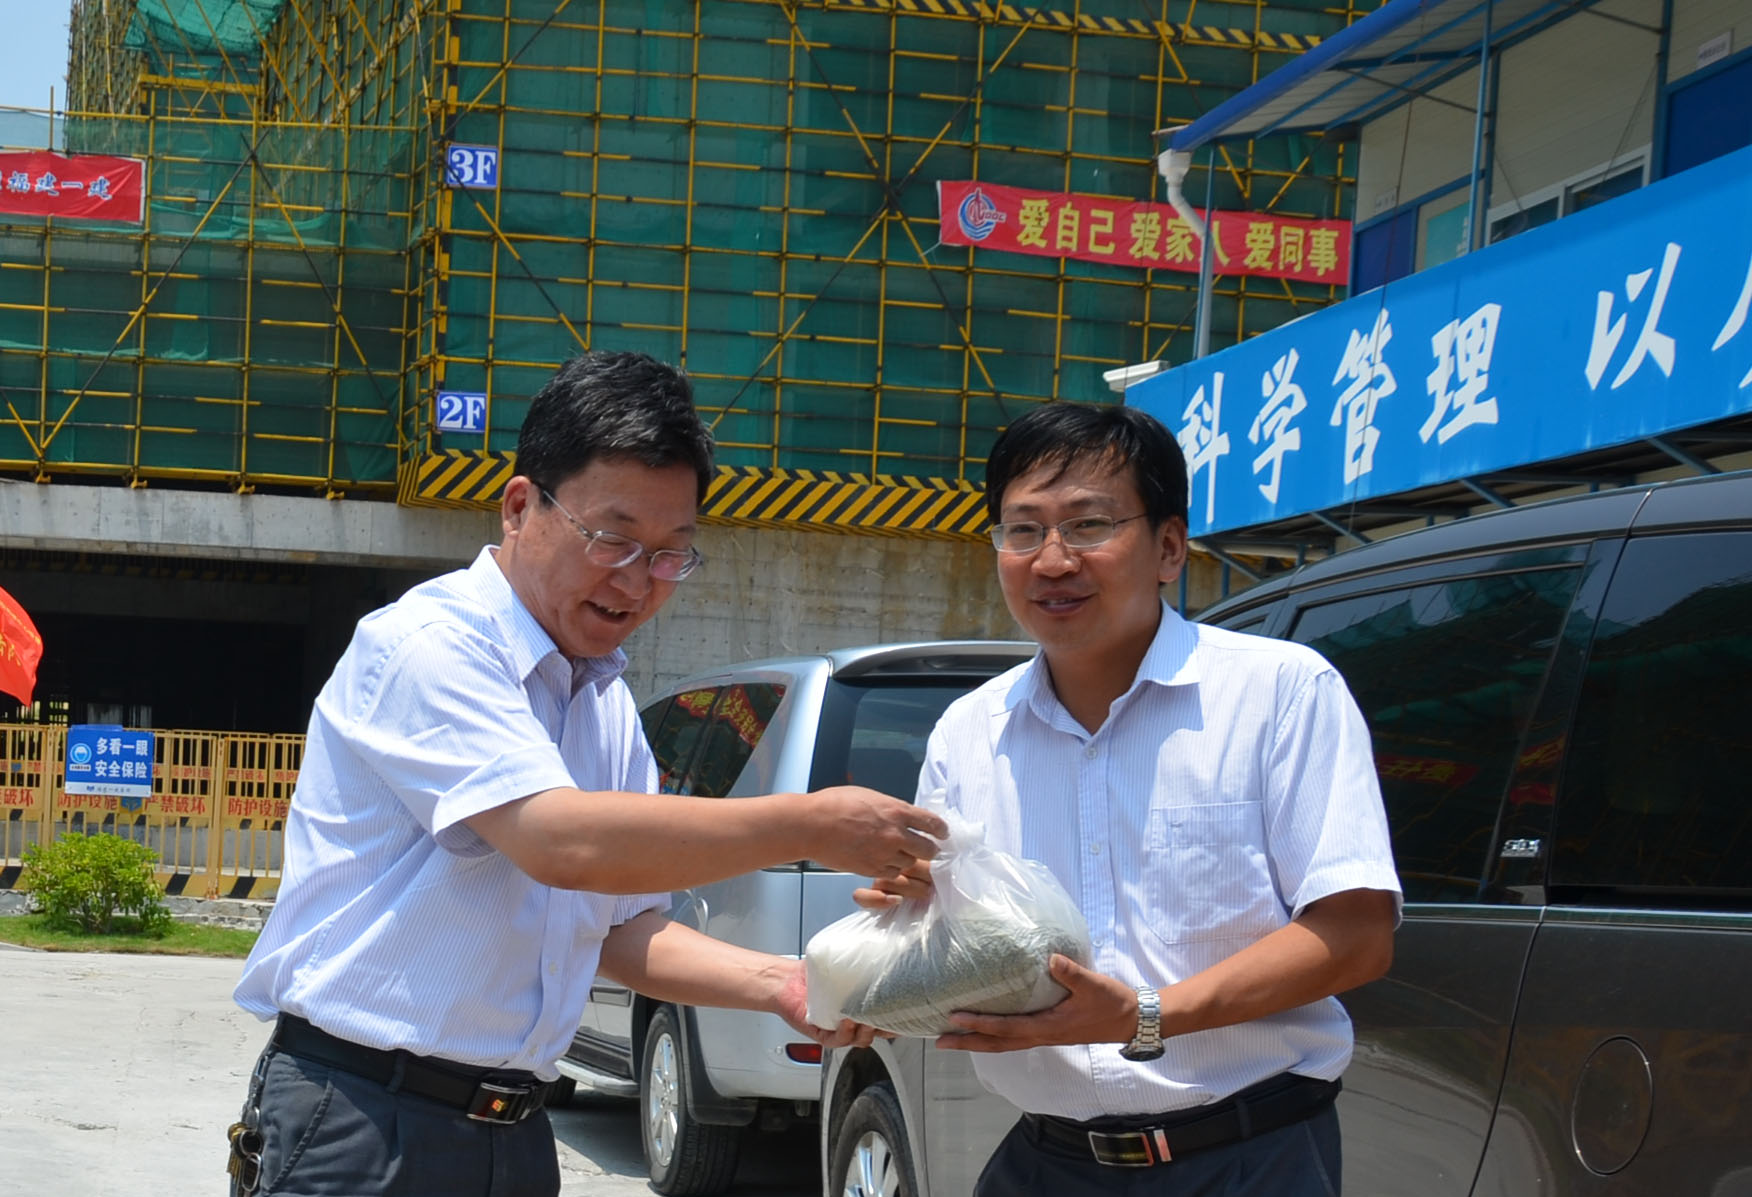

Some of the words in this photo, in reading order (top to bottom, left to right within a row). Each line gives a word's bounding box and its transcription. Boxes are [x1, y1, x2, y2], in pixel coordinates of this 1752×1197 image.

[450, 150, 496, 185] 3F
[1016, 199, 1115, 254] 爱自己
[1243, 221, 1339, 277] 爱同事
[438, 395, 486, 430] 2F
[1177, 303, 1502, 525] 科学管理
[96, 736, 148, 757] 多看一眼
[94, 759, 147, 779] 安全保险
[144, 797, 206, 815] 严禁破坏
[227, 798, 288, 819] 防护设施
